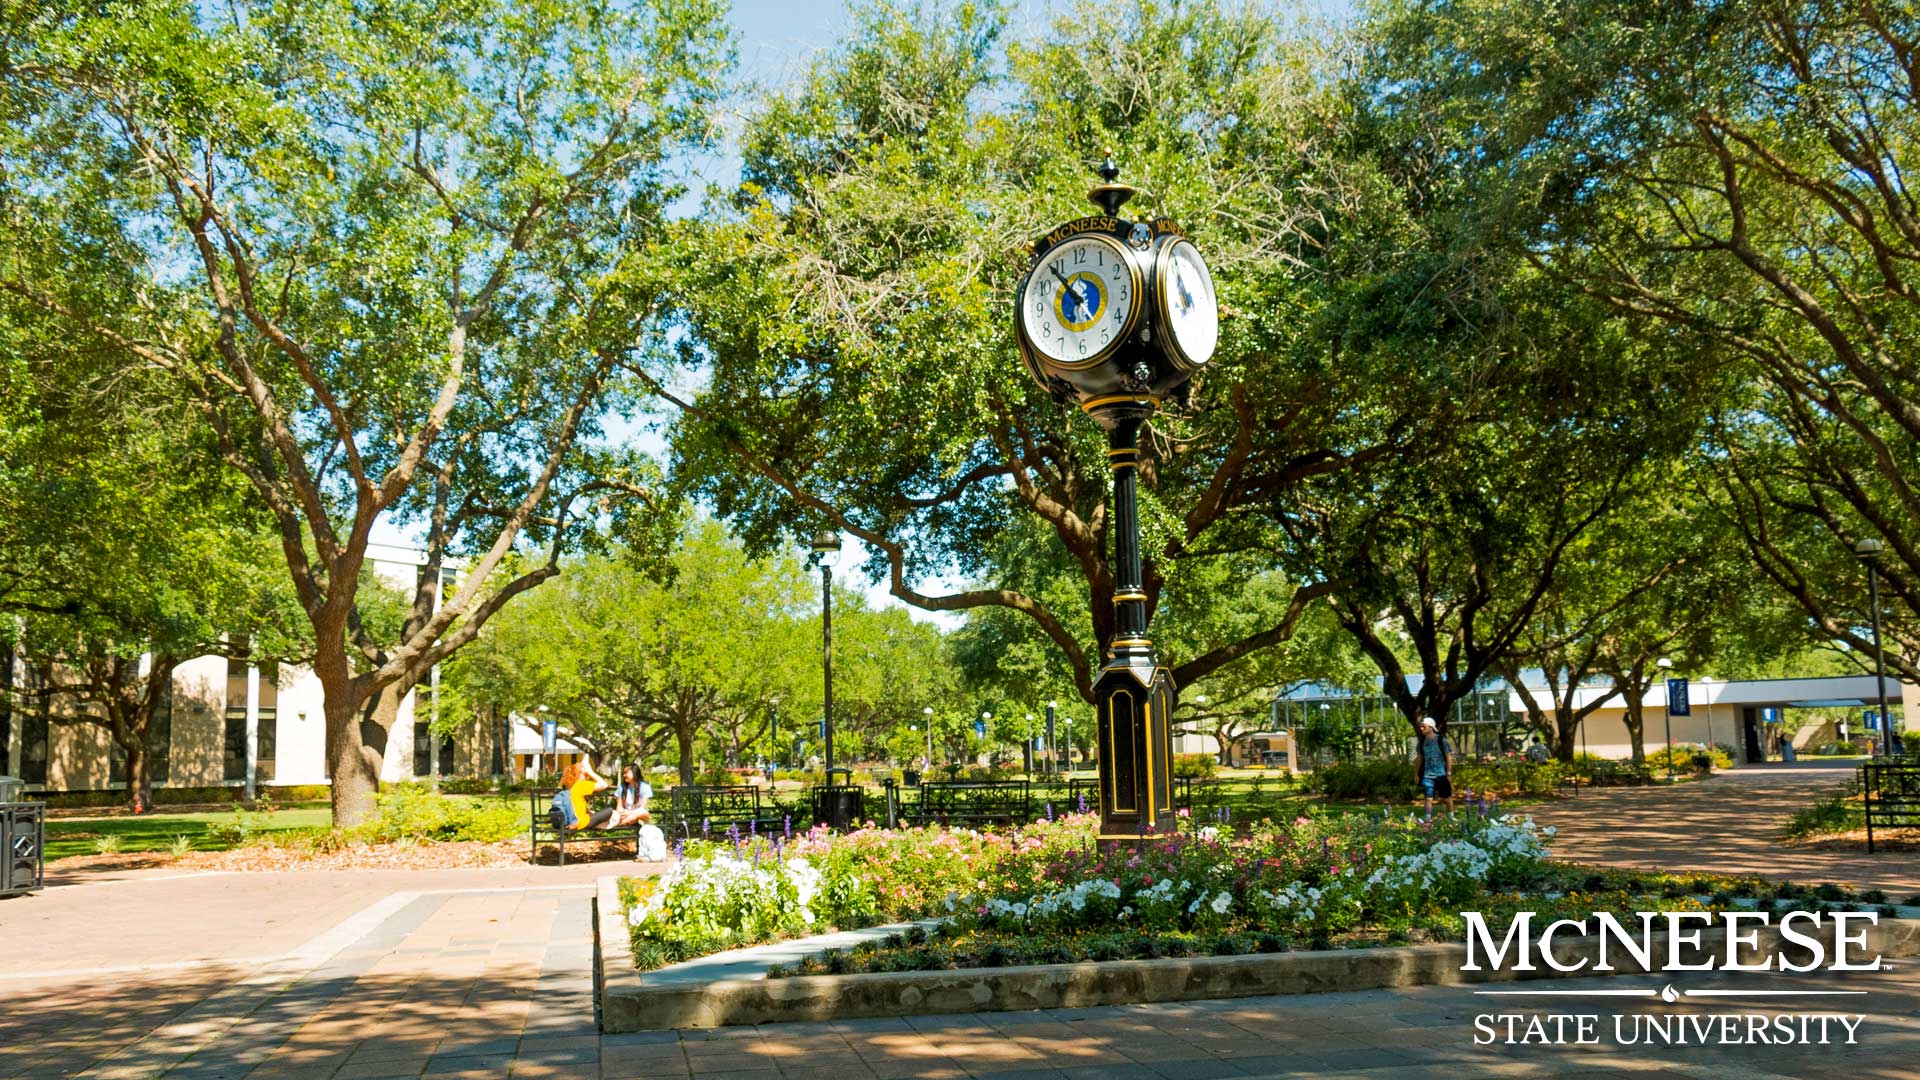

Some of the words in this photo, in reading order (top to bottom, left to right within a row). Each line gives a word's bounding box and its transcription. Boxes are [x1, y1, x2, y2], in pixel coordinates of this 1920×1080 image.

[1073, 248, 1086, 264] 12
[1098, 250, 1103, 266] 1
[1055, 258, 1064, 273] 11
[1112, 264, 1120, 280] 2
[1040, 280, 1051, 296] 10
[1120, 285, 1127, 301] 3
[1036, 302, 1043, 318] 9
[1114, 307, 1122, 323] 4
[1043, 322, 1051, 337] 8
[1100, 328, 1109, 344] 5
[1057, 337, 1065, 353] 7
[1079, 339, 1087, 355] 6
